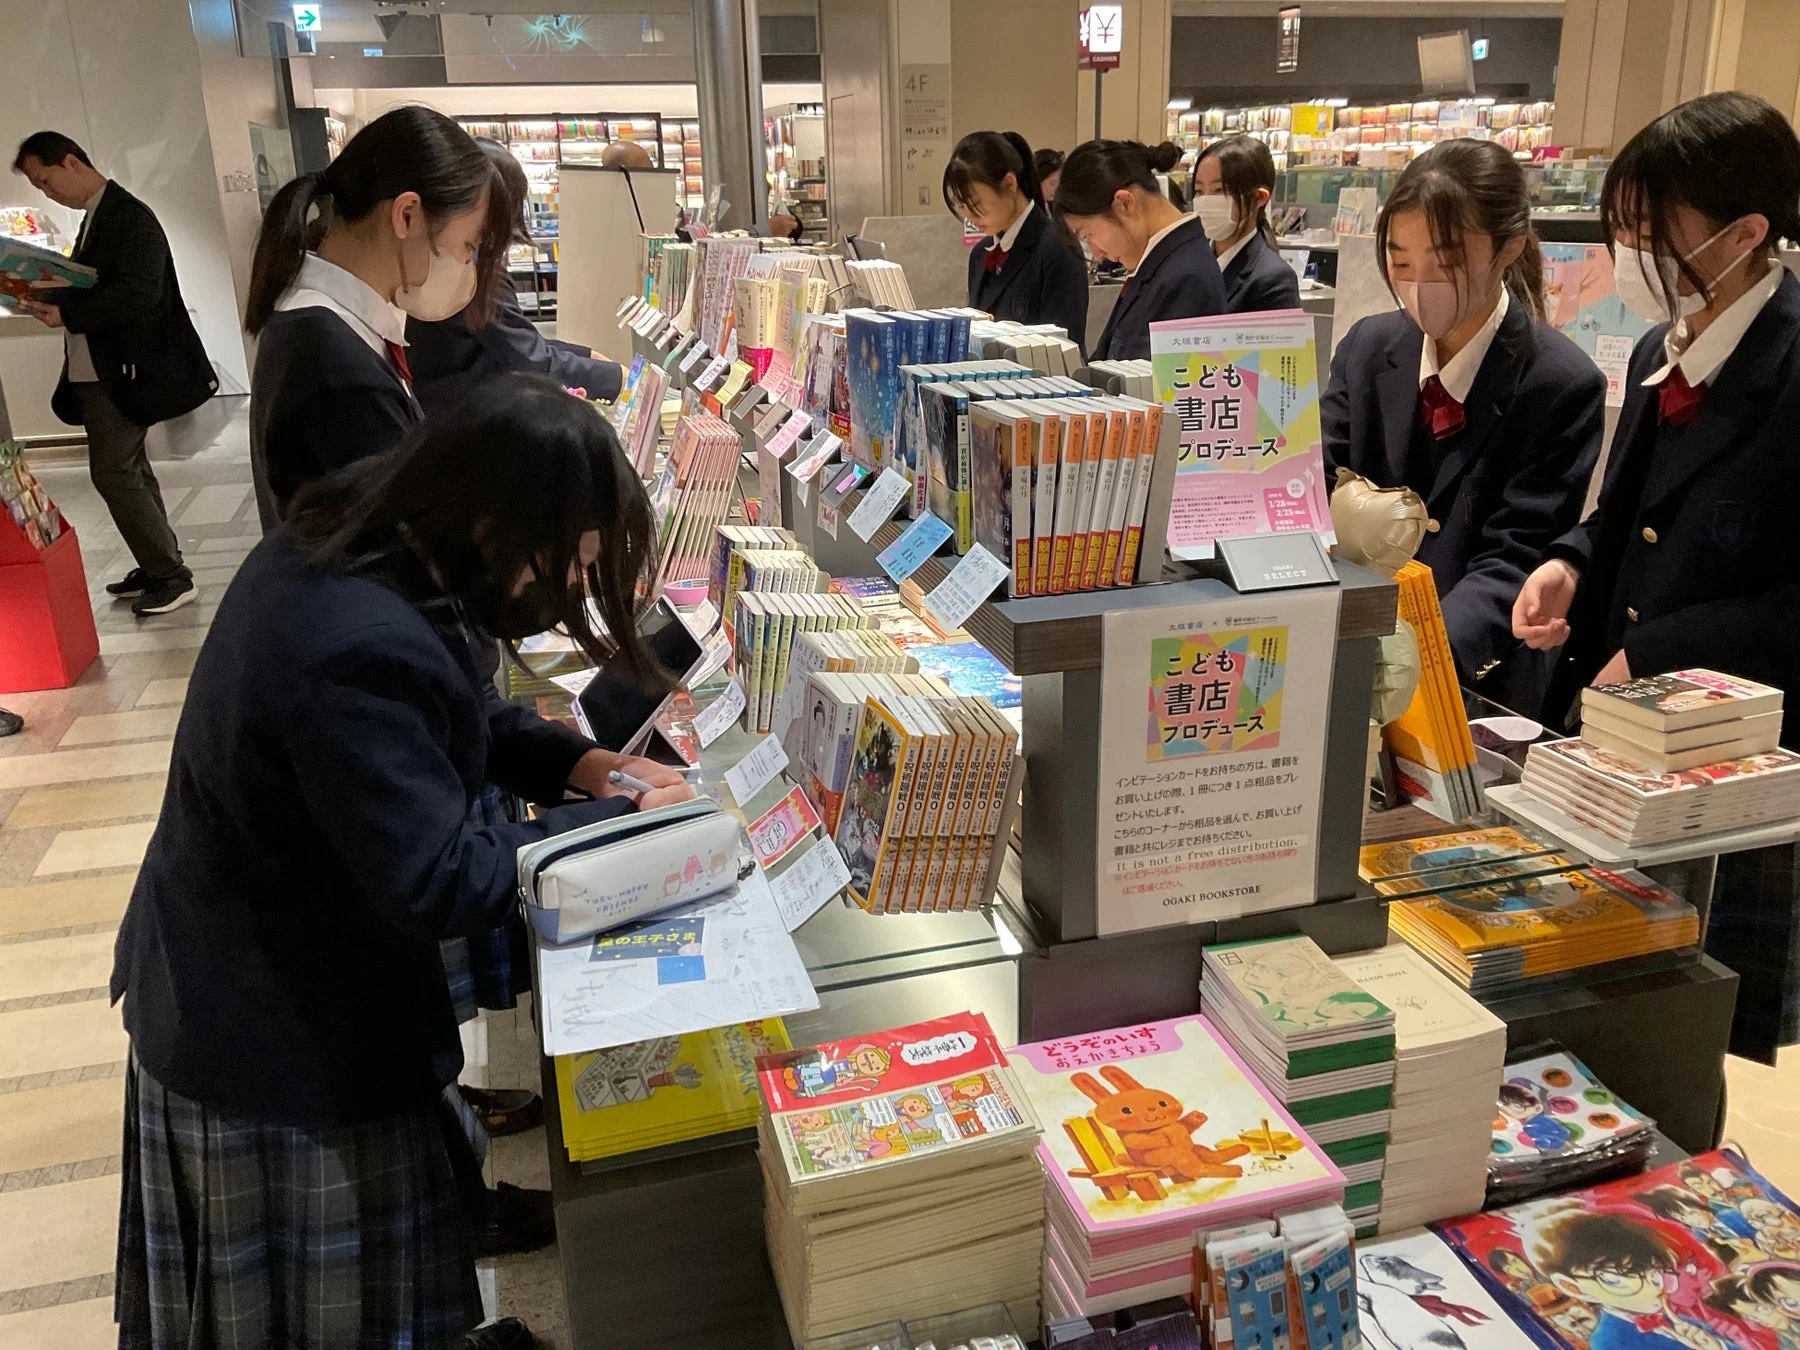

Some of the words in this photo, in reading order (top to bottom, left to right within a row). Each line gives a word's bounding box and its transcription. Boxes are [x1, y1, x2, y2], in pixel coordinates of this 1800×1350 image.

[904, 73, 928, 92] 4F
[1172, 337, 1211, 346] 大垣書店
[1173, 363, 1242, 389] こども
[1174, 395, 1241, 431] 書店
[1178, 438, 1280, 461] プロデュース
[1017, 541, 1029, 594] 映画原作
[1036, 539, 1050, 593] 映画原作
[1052, 538, 1070, 592] 映画原作
[1068, 535, 1085, 589] 映画原作
[1084, 533, 1103, 587] 映画原作
[1100, 532, 1119, 585] 映画原作
[1121, 529, 1140, 582] 映画原作
[1263, 570, 1307, 581] SELECT
[1169, 621, 1204, 631] 大垣書店
[1166, 650, 1234, 676] こども
[1164, 679, 1230, 716] 書店
[1164, 716, 1264, 743] プロデュース
[1115, 756, 1300, 789] インビテーションカードをお持ちの方は、書籍を
[1114, 804, 1303, 839] こちらのコーナーから粗品を選んで、お買い上げ
[1115, 805, 1185, 823] ゼントいたします。
[1114, 831, 1253, 857] 書籍と共にレジまでお持ちください。
[1116, 860, 1128, 871] It
[1133, 859, 1144, 869] is
[1149, 855, 1168, 867] not
[1175, 855, 1182, 863] a
[1187, 849, 1213, 861] free
[1217, 838, 1299, 856] distribution.
[1162, 894, 1196, 907] OGAKI
[1199, 885, 1261, 901] BOOKSTORE
[1386, 970, 1408, 979] NOTE
[908, 1036, 966, 1060] 一筆箋
[1042, 1027, 1156, 1057] どうぞのいす
[1056, 1041, 1161, 1069] おえかきちょう
